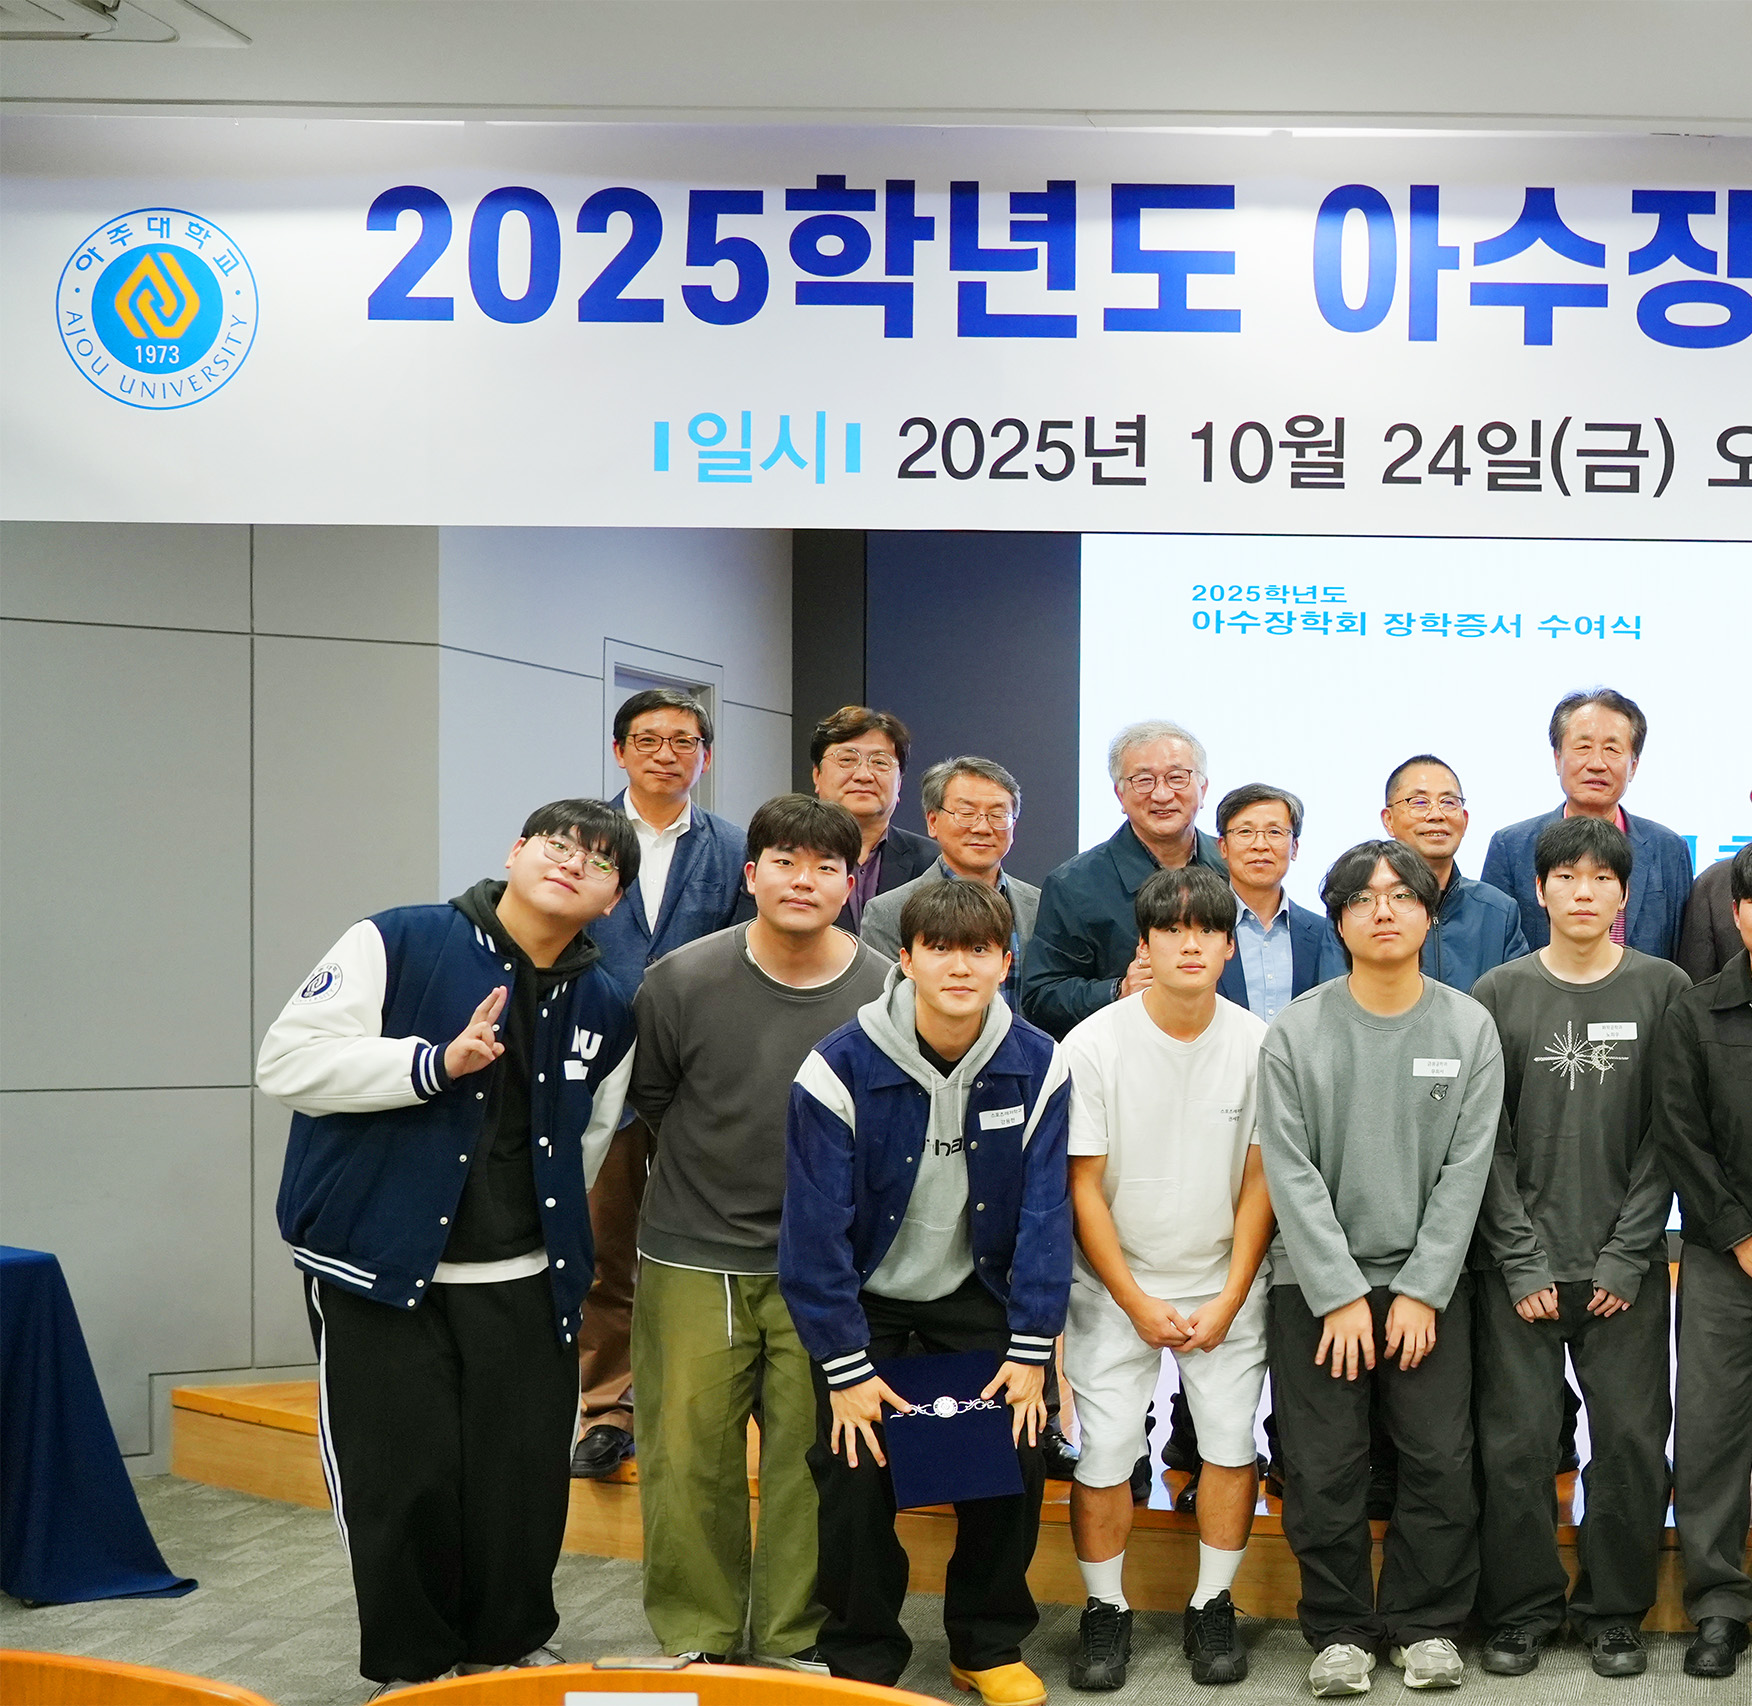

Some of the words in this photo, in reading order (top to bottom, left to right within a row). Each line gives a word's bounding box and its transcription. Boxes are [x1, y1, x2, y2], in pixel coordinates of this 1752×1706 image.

[75, 216, 240, 278] 아주대학교
[366, 174, 1243, 340] 2025학년도
[64, 310, 110, 377] AJOU
[119, 313, 248, 400] UNIVERSITY
[134, 344, 181, 364] 1973
[687, 411, 827, 485] 일시
[897, 415, 1148, 487] 2025년
[1191, 415, 1346, 491] 10월
[1383, 416, 1676, 498] 24일(금)
[1191, 584, 1349, 605] 2025학년도
[1192, 610, 1368, 637] 아수장학회
[1383, 612, 1523, 639] 장학증서
[1537, 613, 1643, 641] 수여식
